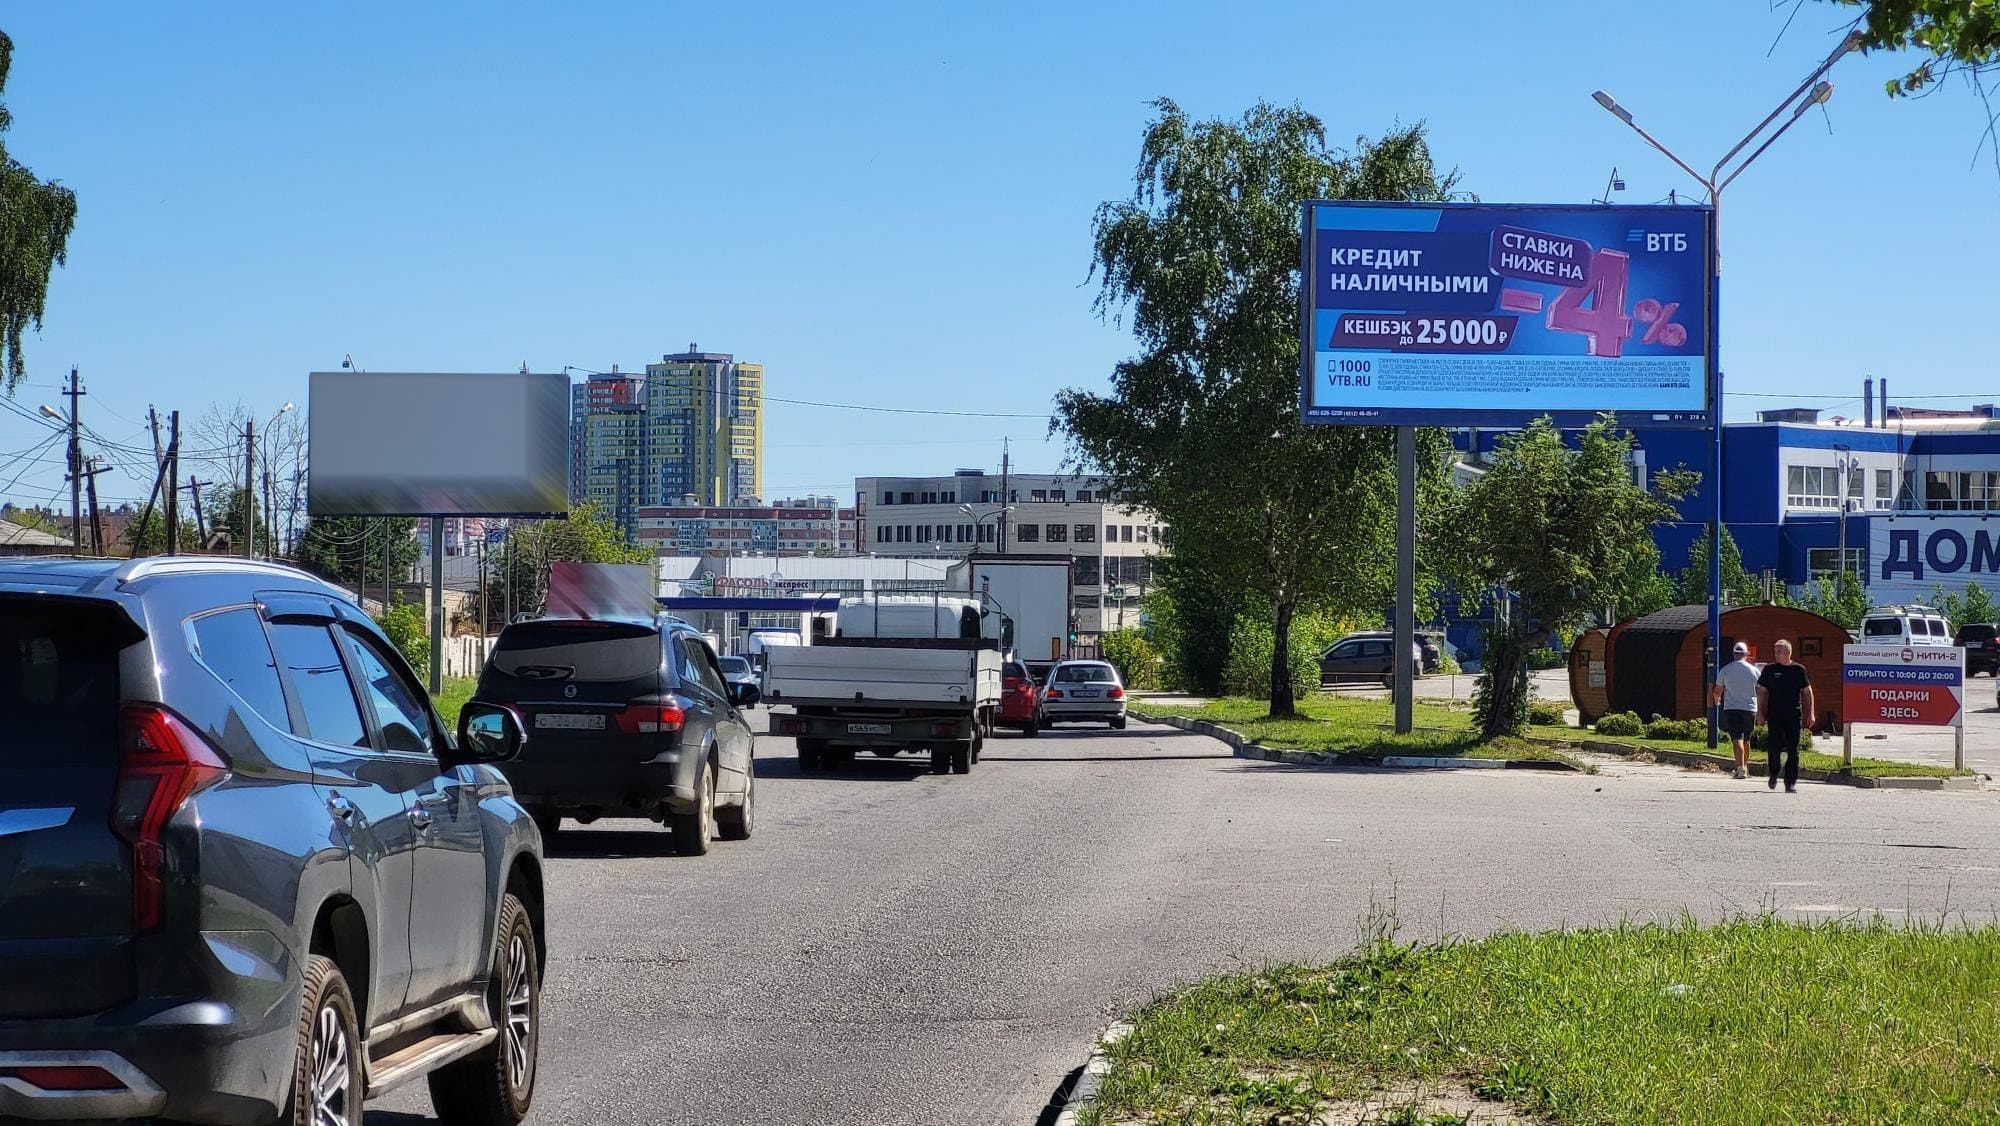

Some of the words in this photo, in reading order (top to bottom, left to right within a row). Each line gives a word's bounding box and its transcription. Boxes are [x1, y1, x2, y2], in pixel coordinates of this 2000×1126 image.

[1502, 232, 1573, 259] СТАВКИ
[1647, 233, 1687, 252] ВТБ
[1331, 248, 1422, 269] КРЕДИТ
[1500, 253, 1555, 276] НИЖЕ
[1559, 264, 1584, 281] НА
[1331, 274, 1488, 293] НАЛИЧНЫМИ
[1344, 319, 1412, 335] КЕШБЭК
[1340, 359, 1371, 373] 1000
[1329, 375, 1371, 387] VTB.RU
[1882, 528, 2000, 580] ДОМ
[715, 576, 769, 588] ФАСОЛЬ
[1917, 652, 1957, 661] НИТИ-2
[1847, 669, 1888, 678] ОТКРЫТО
[1896, 671, 1917, 679] 10:00
[1918, 672, 1931, 680] ДО
[1932, 672, 1955, 680] 20:00
[1870, 689, 1930, 701] ПОДАРКИ
[1880, 706, 1919, 719] ЗДЕСЬ
